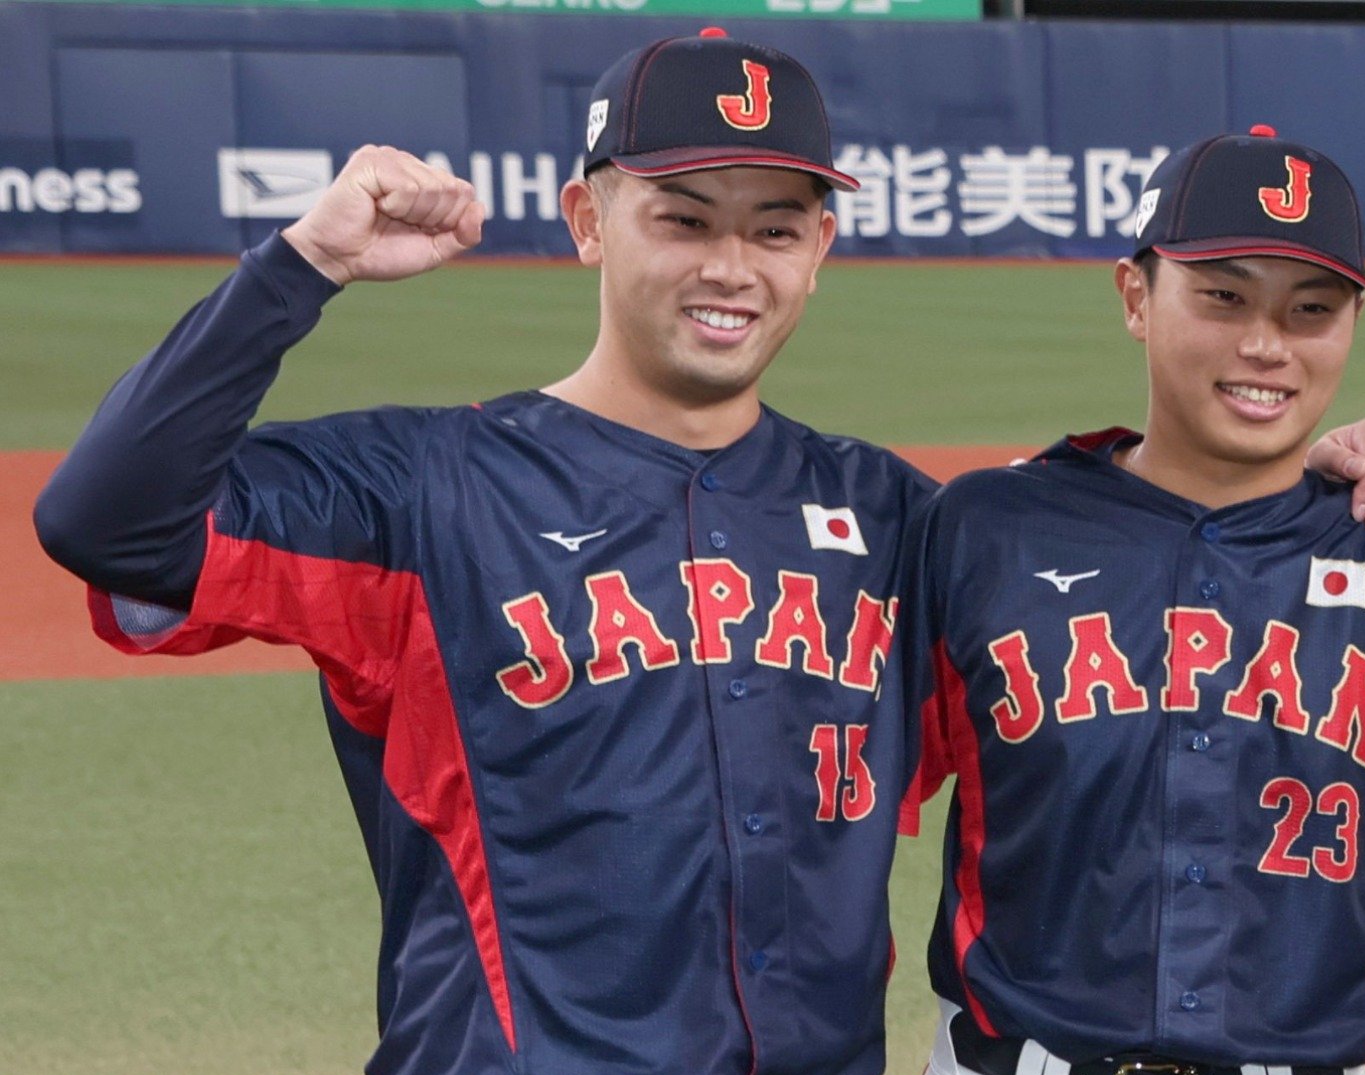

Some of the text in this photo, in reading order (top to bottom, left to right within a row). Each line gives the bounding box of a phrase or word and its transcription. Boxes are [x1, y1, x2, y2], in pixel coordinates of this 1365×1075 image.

[717, 60, 771, 130] J
[0, 167, 142, 213] ness
[1258, 156, 1312, 223] J
[809, 724, 876, 822] 15
[1258, 777, 1360, 884] 23
